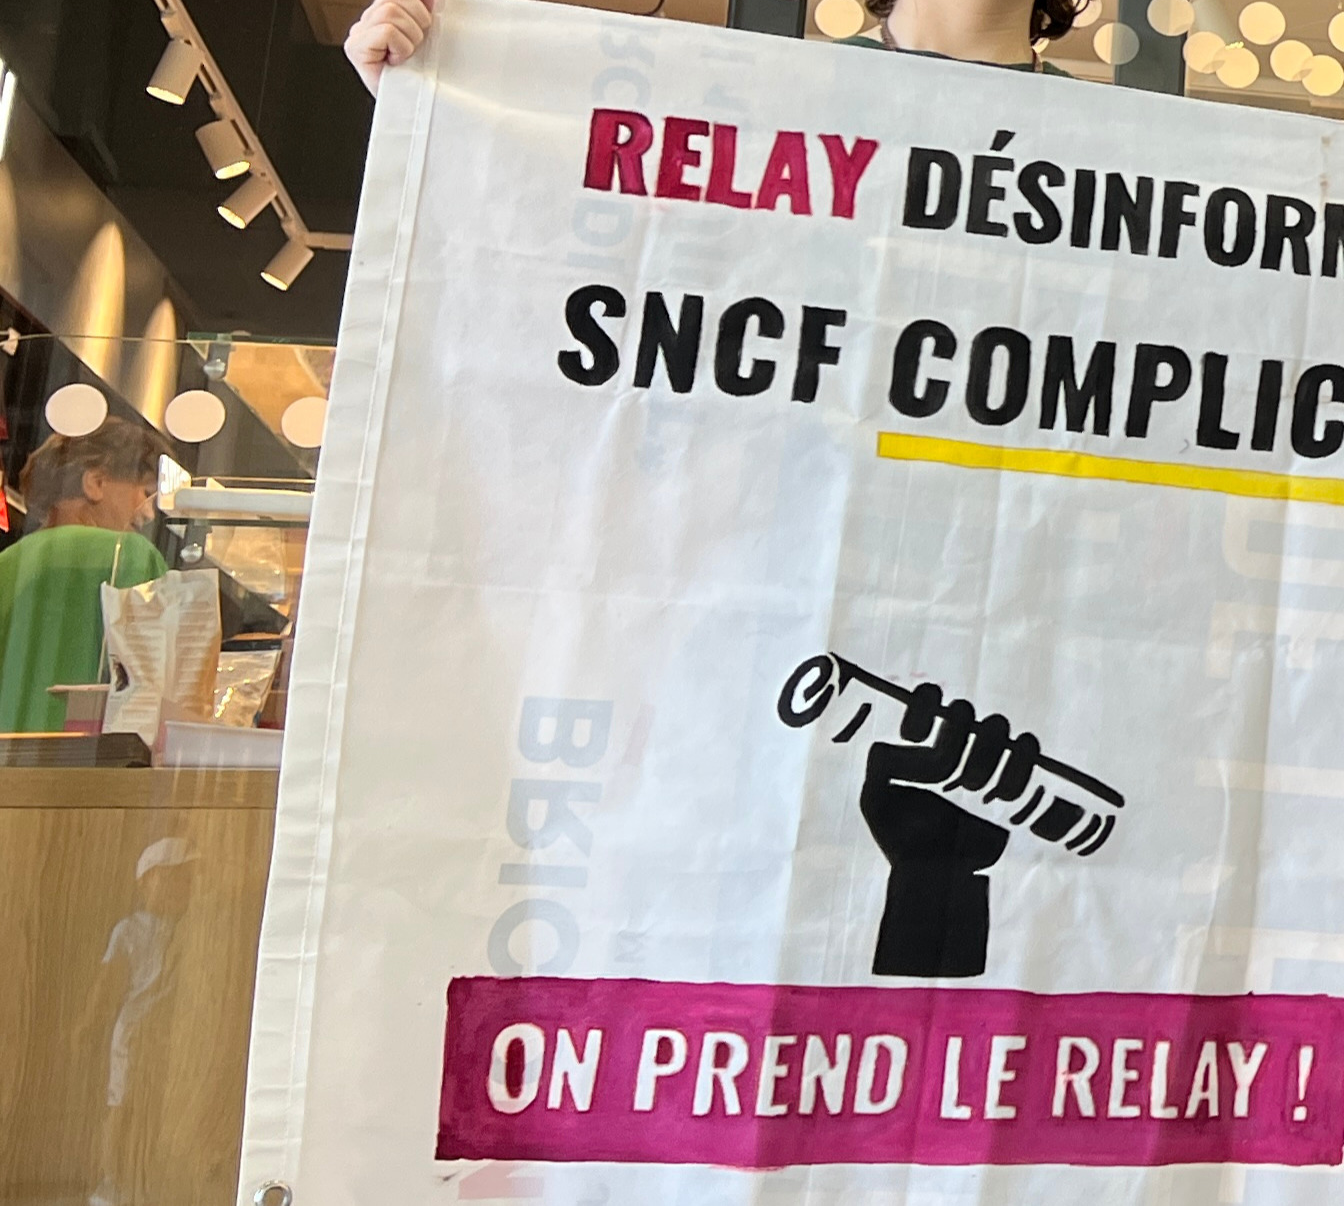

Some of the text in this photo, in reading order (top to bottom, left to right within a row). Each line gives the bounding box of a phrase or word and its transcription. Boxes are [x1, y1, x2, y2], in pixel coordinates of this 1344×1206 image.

[582, 107, 881, 221] RELAY
[557, 283, 847, 403] SNCF
[486, 1021, 1311, 1124] ON PREND LE RELAY !
